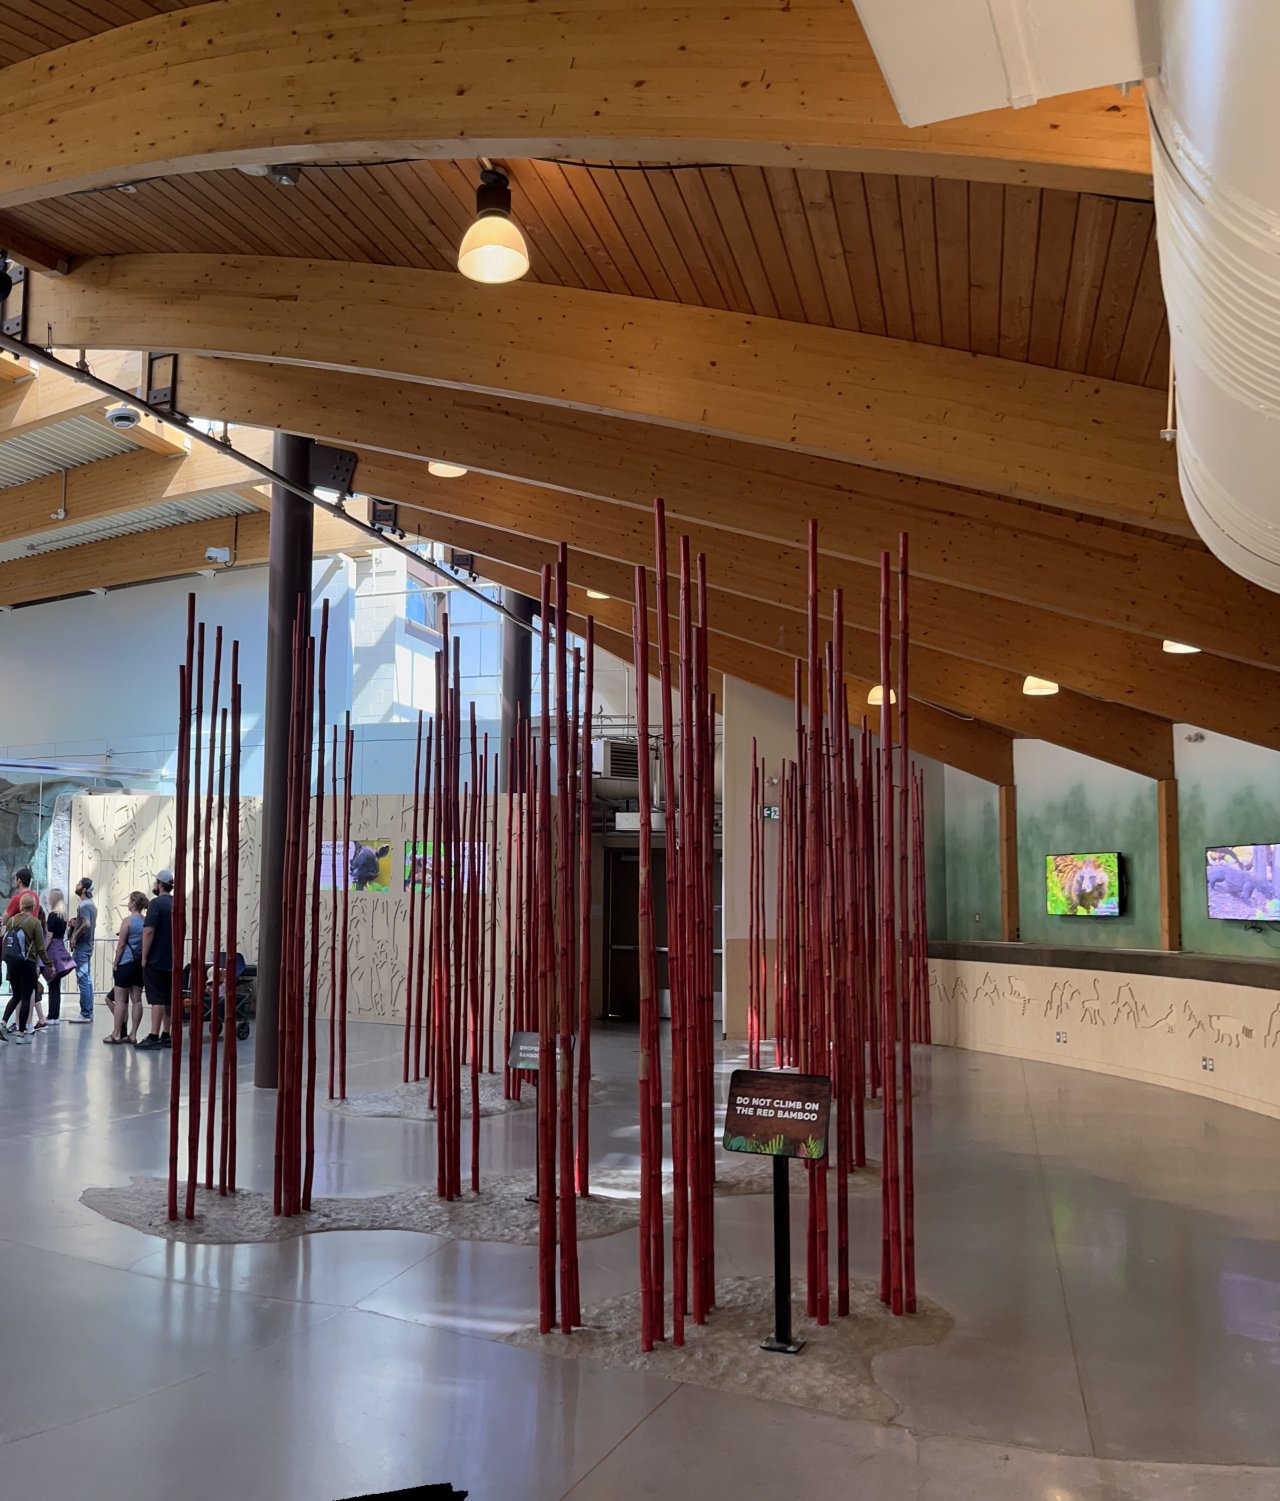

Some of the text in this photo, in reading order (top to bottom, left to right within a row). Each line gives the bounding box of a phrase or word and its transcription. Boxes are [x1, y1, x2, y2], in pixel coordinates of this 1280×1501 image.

[736, 1096, 819, 1110] DO NOT CLIMB ON
[735, 1106, 818, 1121] THE RED BAMBOO
